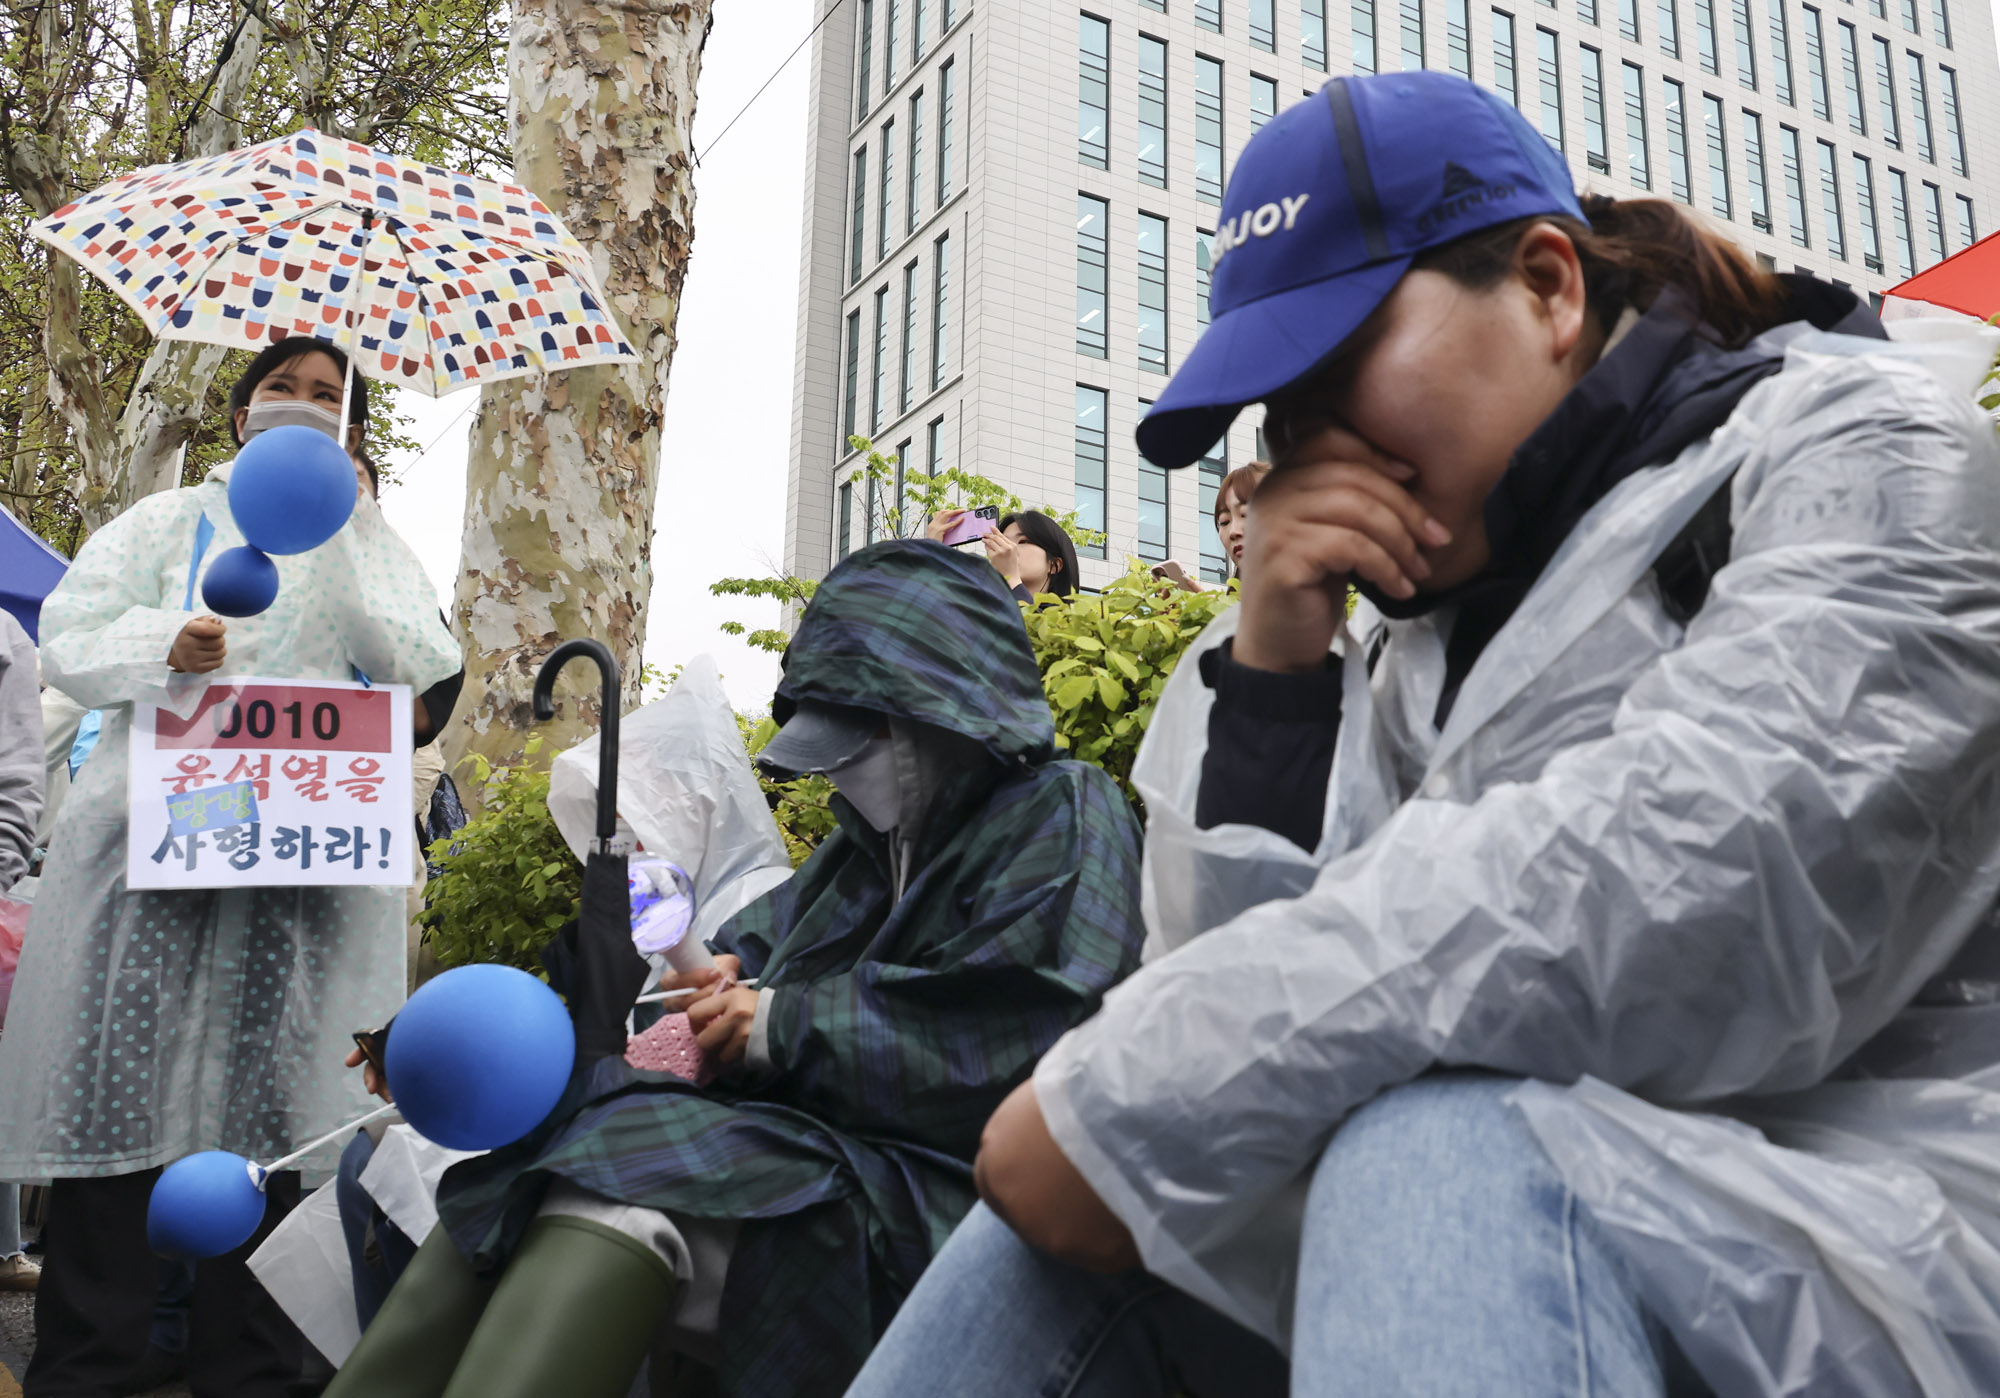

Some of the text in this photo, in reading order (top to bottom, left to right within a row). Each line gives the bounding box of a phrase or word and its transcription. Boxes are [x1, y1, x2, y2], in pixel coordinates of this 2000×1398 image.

[213, 699, 340, 740] 0010
[161, 753, 386, 803] 윤석열을
[151, 822, 392, 871] 사형하라!
